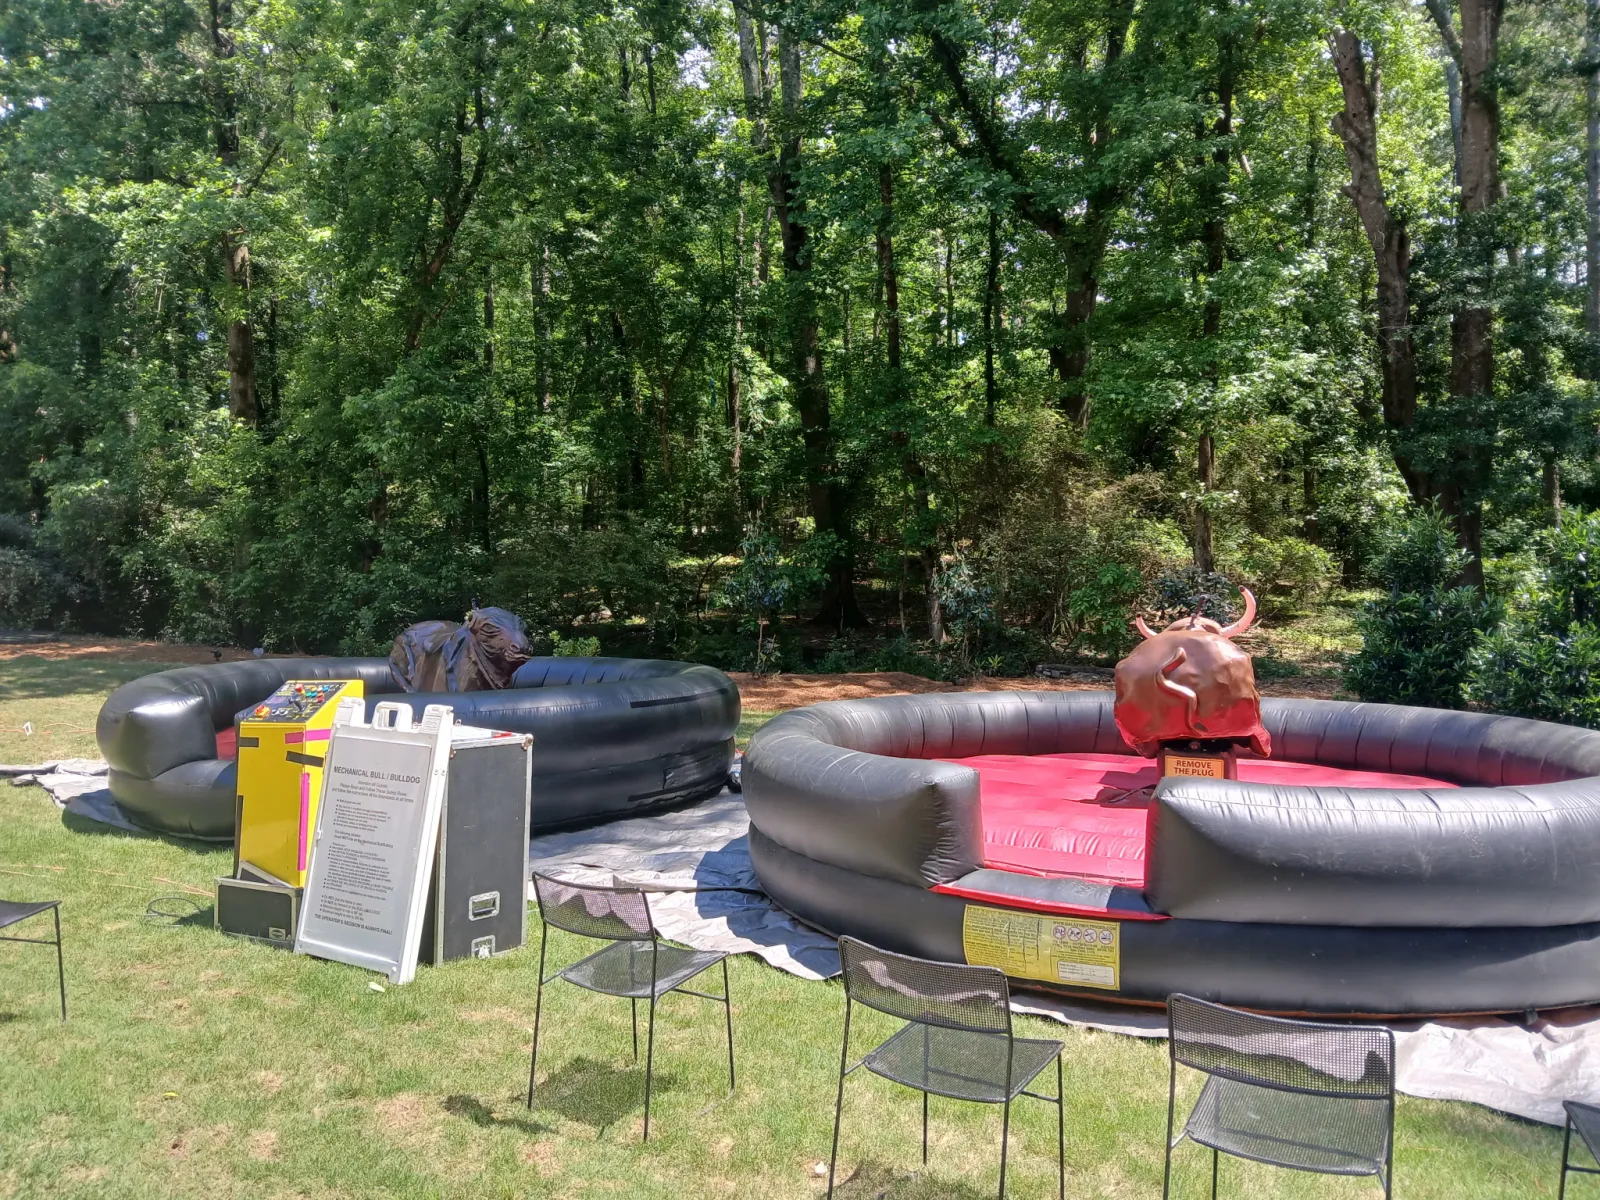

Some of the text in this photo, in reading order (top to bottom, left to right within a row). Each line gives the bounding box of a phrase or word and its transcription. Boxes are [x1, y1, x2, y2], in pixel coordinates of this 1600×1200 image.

[1176, 760, 1211, 769] REMOVE
[334, 766, 368, 777] MECHANICAL
[370, 771, 385, 780] BULL
[390, 774, 420, 784] BULLDOG
[1174, 767, 1190, 776] THE
[322, 915, 343, 924] OPERATOR'S
